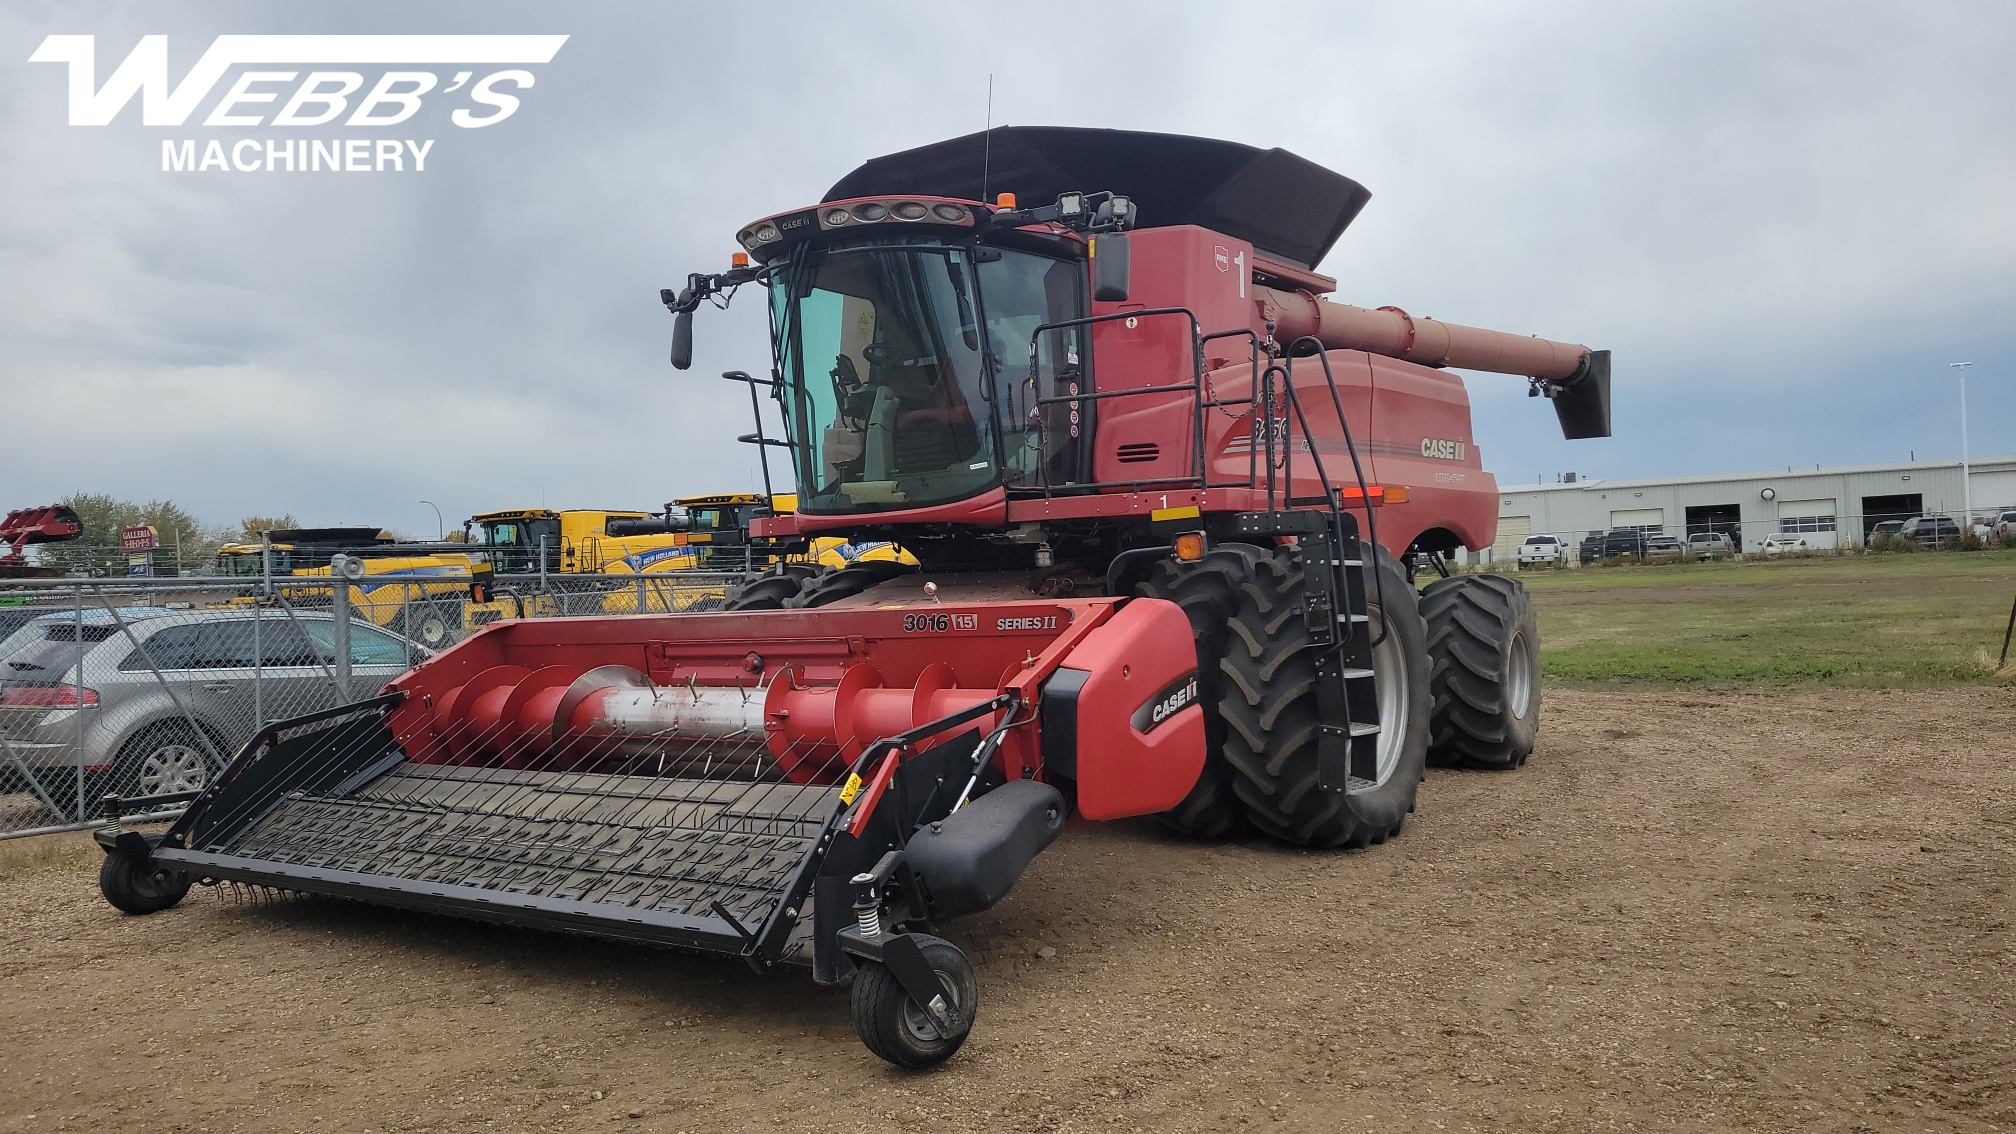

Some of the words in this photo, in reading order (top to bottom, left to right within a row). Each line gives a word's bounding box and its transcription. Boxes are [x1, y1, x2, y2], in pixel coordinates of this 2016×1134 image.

[782, 219, 802, 230] CASE
[1234, 250, 1245, 299] 1
[1421, 437, 1455, 460] CASE
[1159, 494, 1167, 509] 1
[122, 529, 151, 540] GALLERIA
[643, 555, 655, 565] NEW
[655, 549, 680, 561] HOLLAND
[903, 613, 949, 633] 3016
[957, 616, 973, 628] 15
[996, 617, 1042, 631] SERIES
[1043, 616, 1058, 629] II
[1152, 688, 1186, 722] CASE
